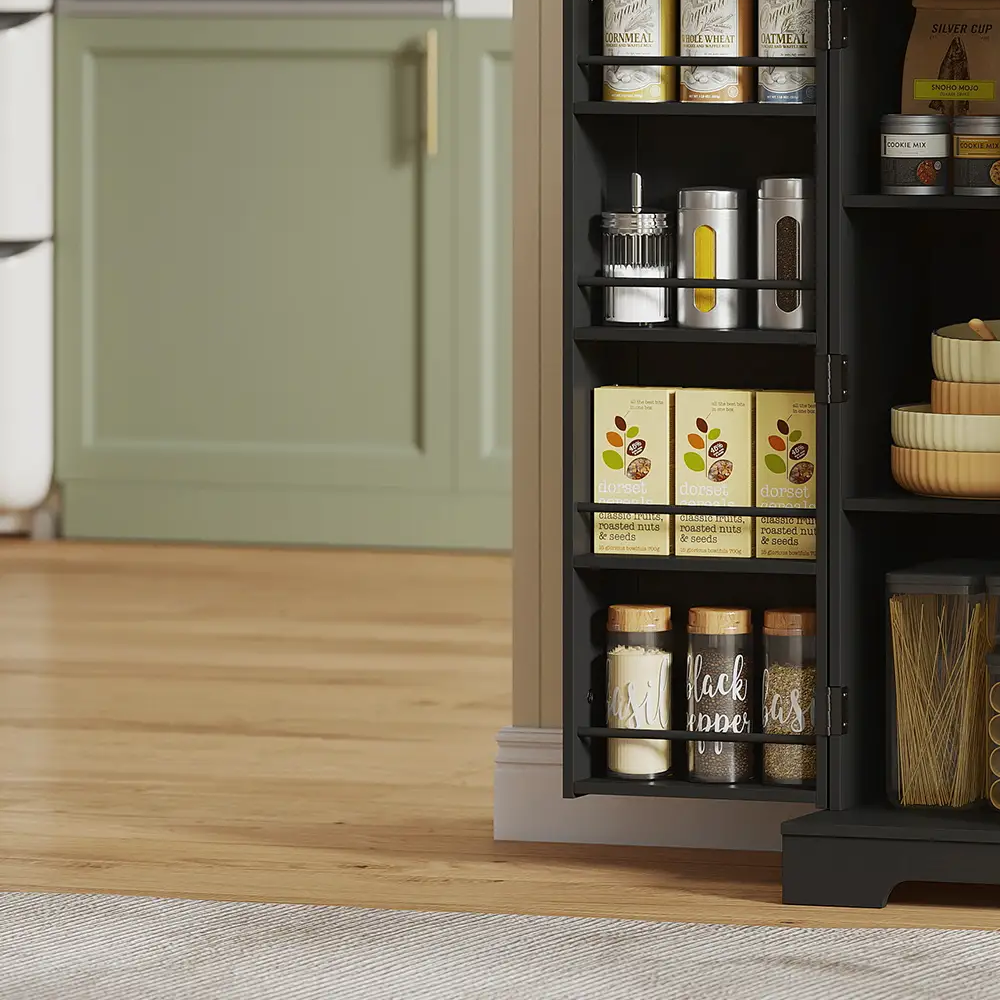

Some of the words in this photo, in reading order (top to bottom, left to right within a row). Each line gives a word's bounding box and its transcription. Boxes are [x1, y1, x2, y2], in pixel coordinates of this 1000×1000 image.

[932, 23, 968, 34] SILVER
[970, 23, 993, 34] CUP
[704, 34, 736, 44] WHEAT
[760, 32, 809, 45] OATMEAL
[958, 84, 979, 92] MOJO
[887, 141, 911, 149] COOKIE
[912, 141, 927, 149] MIX
[959, 142, 984, 150] COOKIE
[985, 142, 1000, 150] MIX
[597, 480, 648, 494] dorset
[679, 481, 729, 496] dorset
[760, 484, 811, 499] dorset
[598, 511, 632, 520] classic
[680, 514, 713, 523] classic
[760, 516, 794, 524] classic
[598, 522, 635, 531] roasted
[637, 523, 660, 531] nuts
[680, 524, 717, 533] roasted
[719, 525, 742, 534] nuts
[760, 526, 798, 535] roasted
[598, 531, 608, 541] &
[609, 532, 636, 541] seeds
[680, 534, 689, 543] &
[690, 534, 718, 543] seeds
[760, 536, 770, 545] &
[771, 536, 799, 546] seeds
